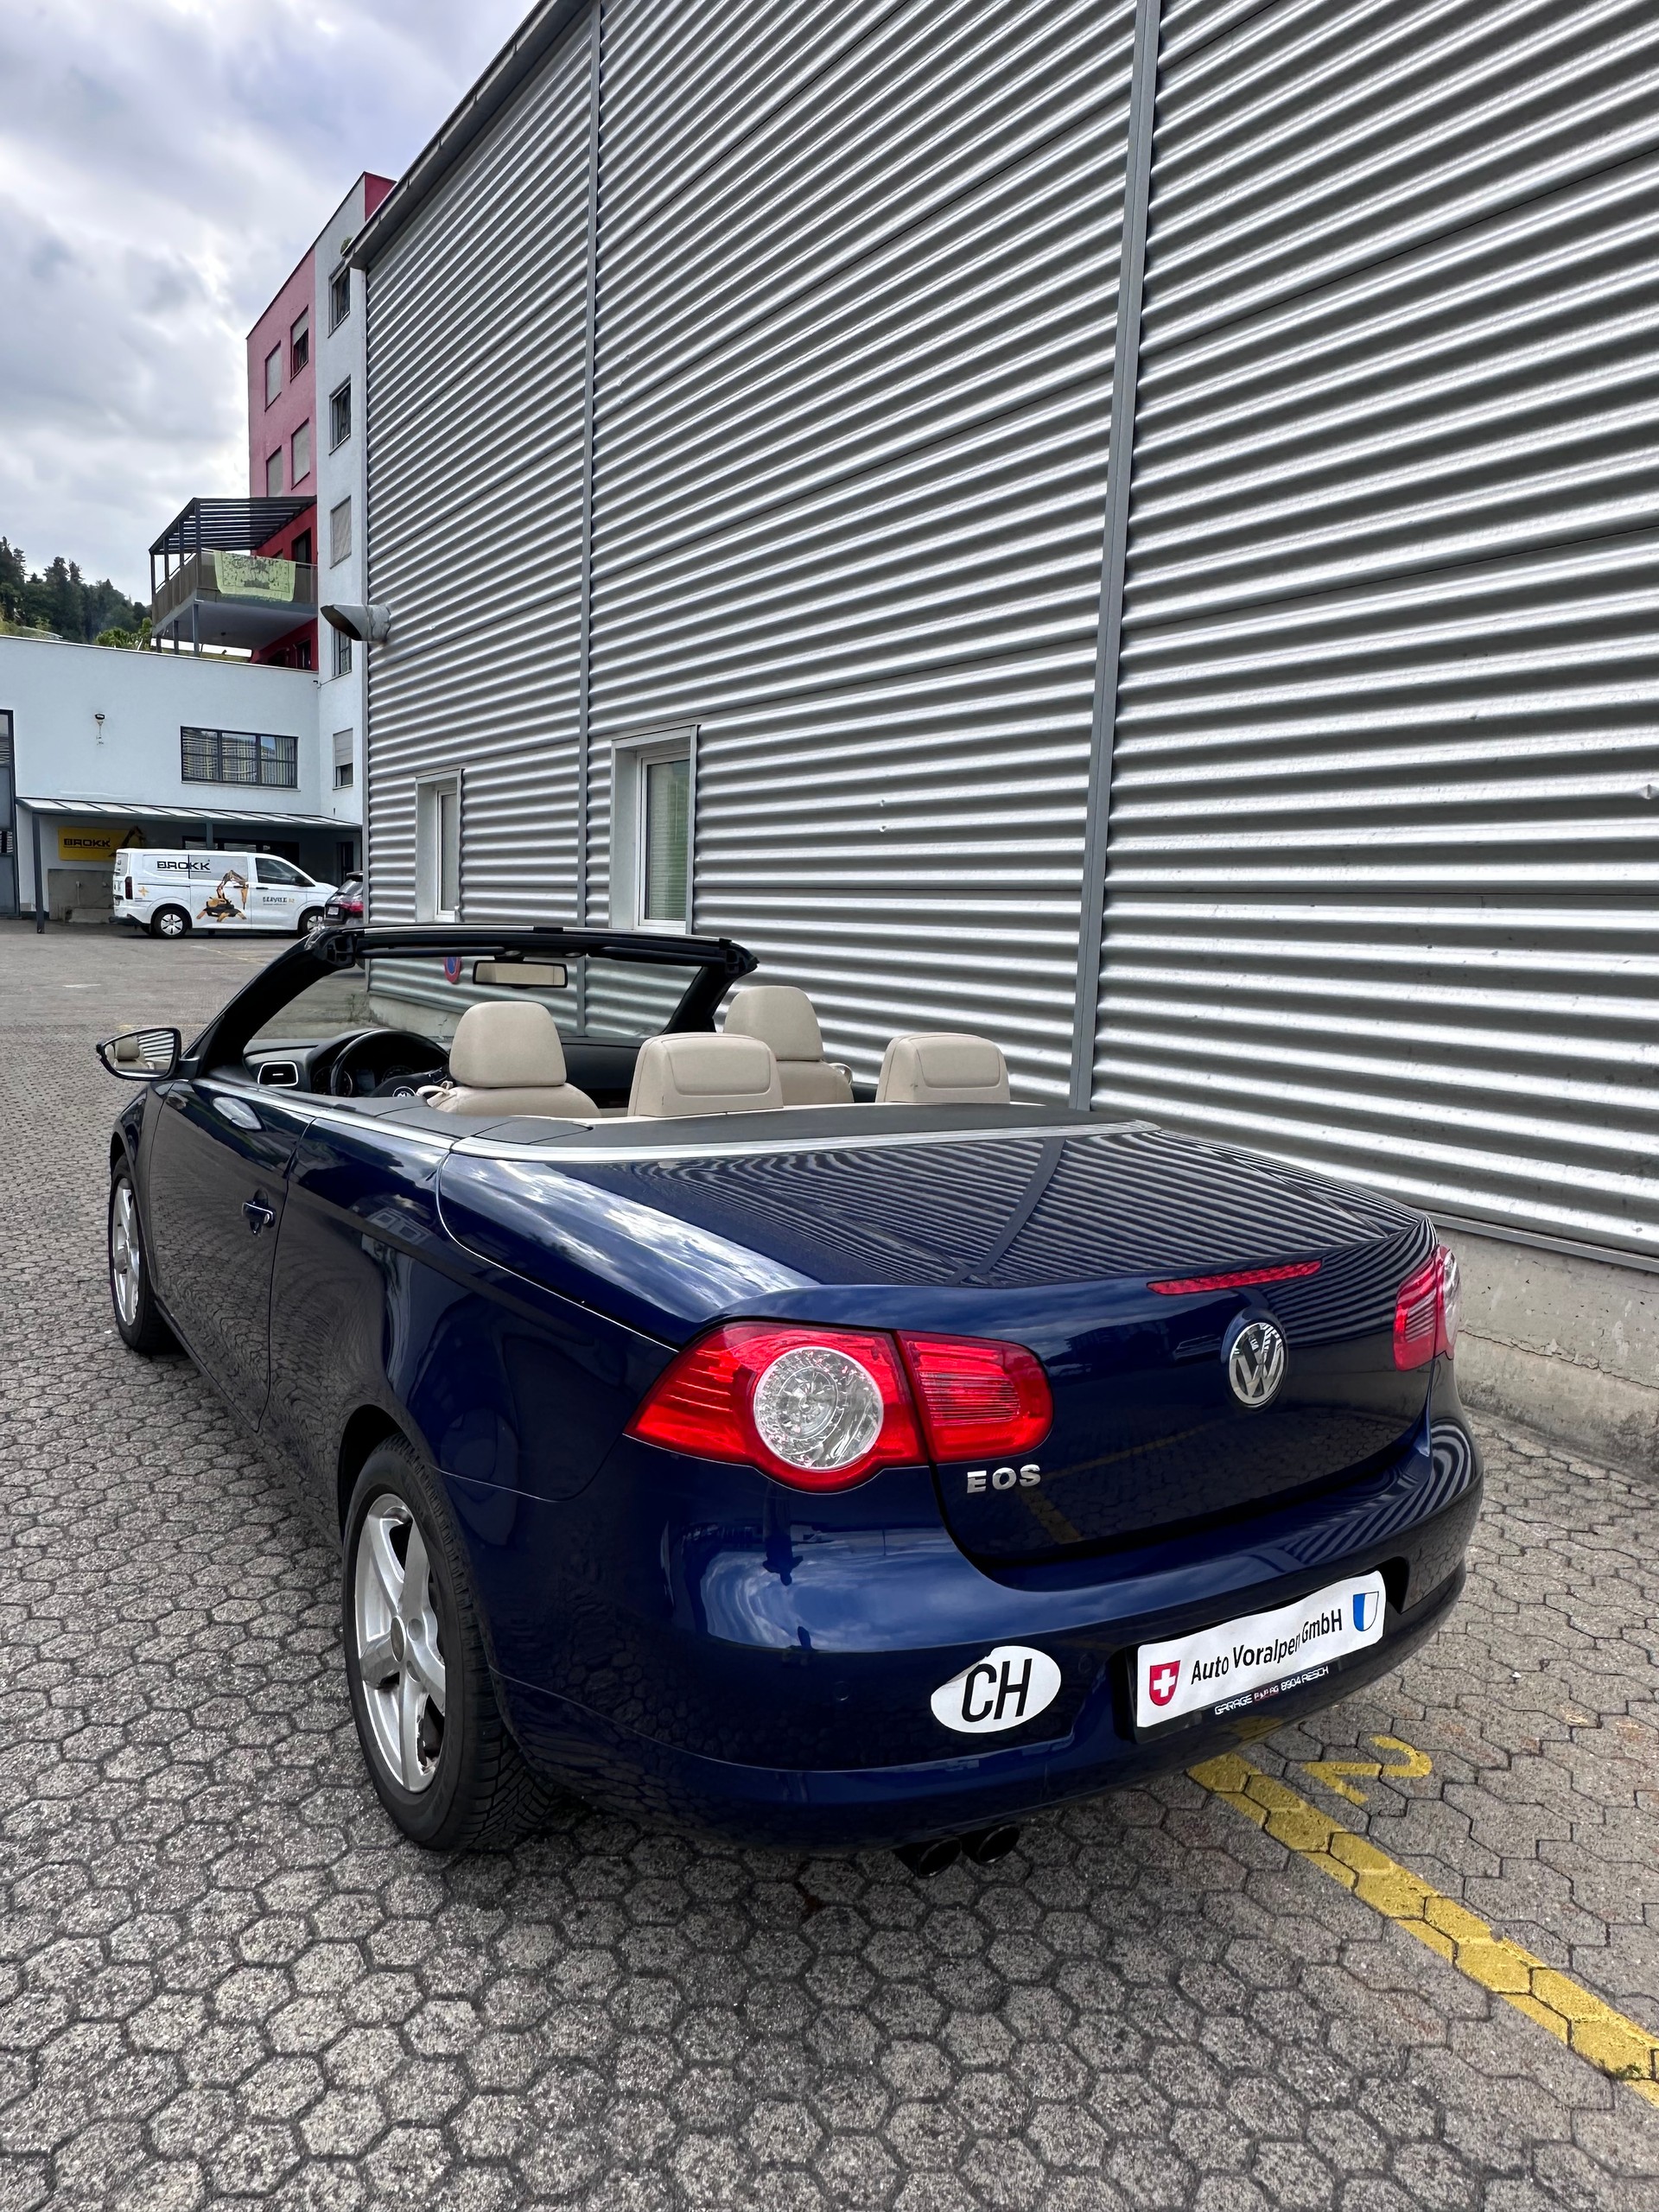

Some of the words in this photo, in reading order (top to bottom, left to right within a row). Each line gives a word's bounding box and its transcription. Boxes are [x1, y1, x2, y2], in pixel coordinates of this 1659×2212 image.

[63, 838, 111, 848] BROKK
[156, 861, 210, 870] BROKK
[967, 1464, 1041, 1493] EOS
[1192, 1658, 1229, 1684] Auto
[1233, 1634, 1300, 1669] Voralpen
[1301, 1608, 1343, 1644] GmbH
[961, 1657, 1033, 1722] CH
